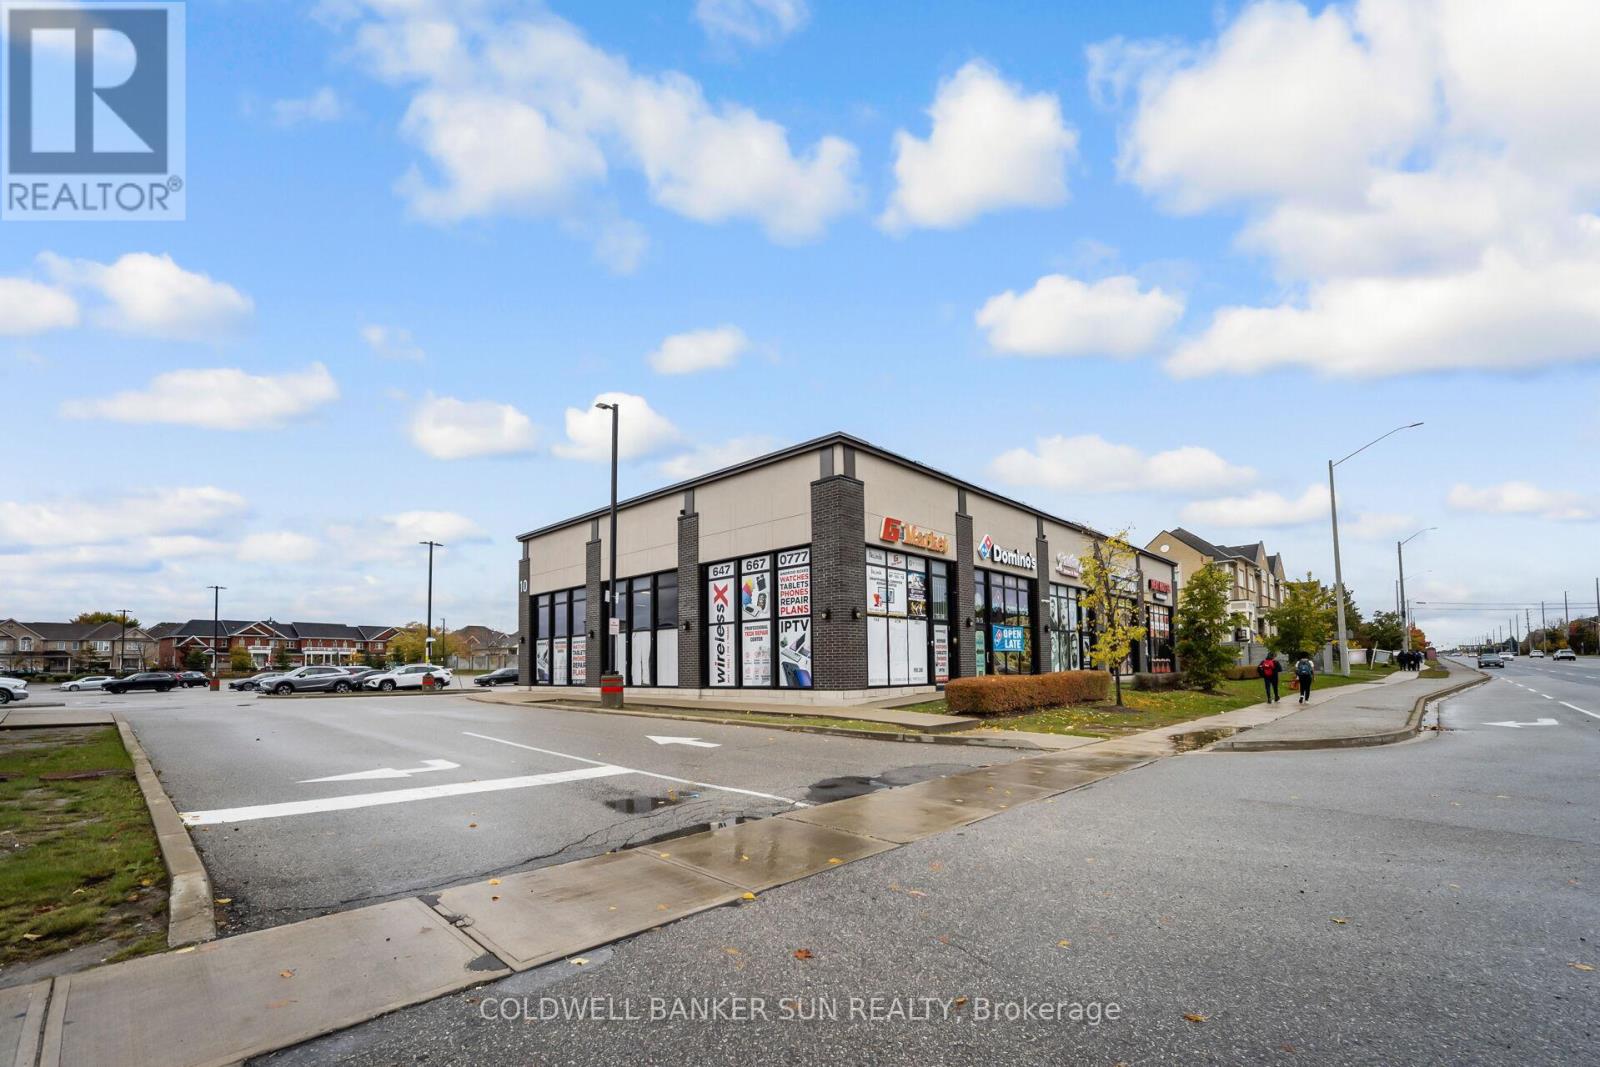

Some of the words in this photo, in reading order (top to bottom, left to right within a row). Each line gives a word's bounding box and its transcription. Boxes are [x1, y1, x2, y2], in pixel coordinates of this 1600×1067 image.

[780, 551, 808, 565] 0777
[993, 543, 1037, 569] Domino's
[746, 558, 766, 571] 667
[712, 565, 731, 576] 647
[780, 573, 809, 582] WATCHES
[520, 579, 528, 592] 10
[780, 581, 809, 590] TABLETS
[780, 588, 809, 597] PHONES
[780, 596, 809, 606] REPAIR
[780, 605, 809, 615] PLANS
[781, 619, 809, 633] IPTV
[1003, 629, 1022, 639] OPEN
[1005, 639, 1021, 649] LATE
